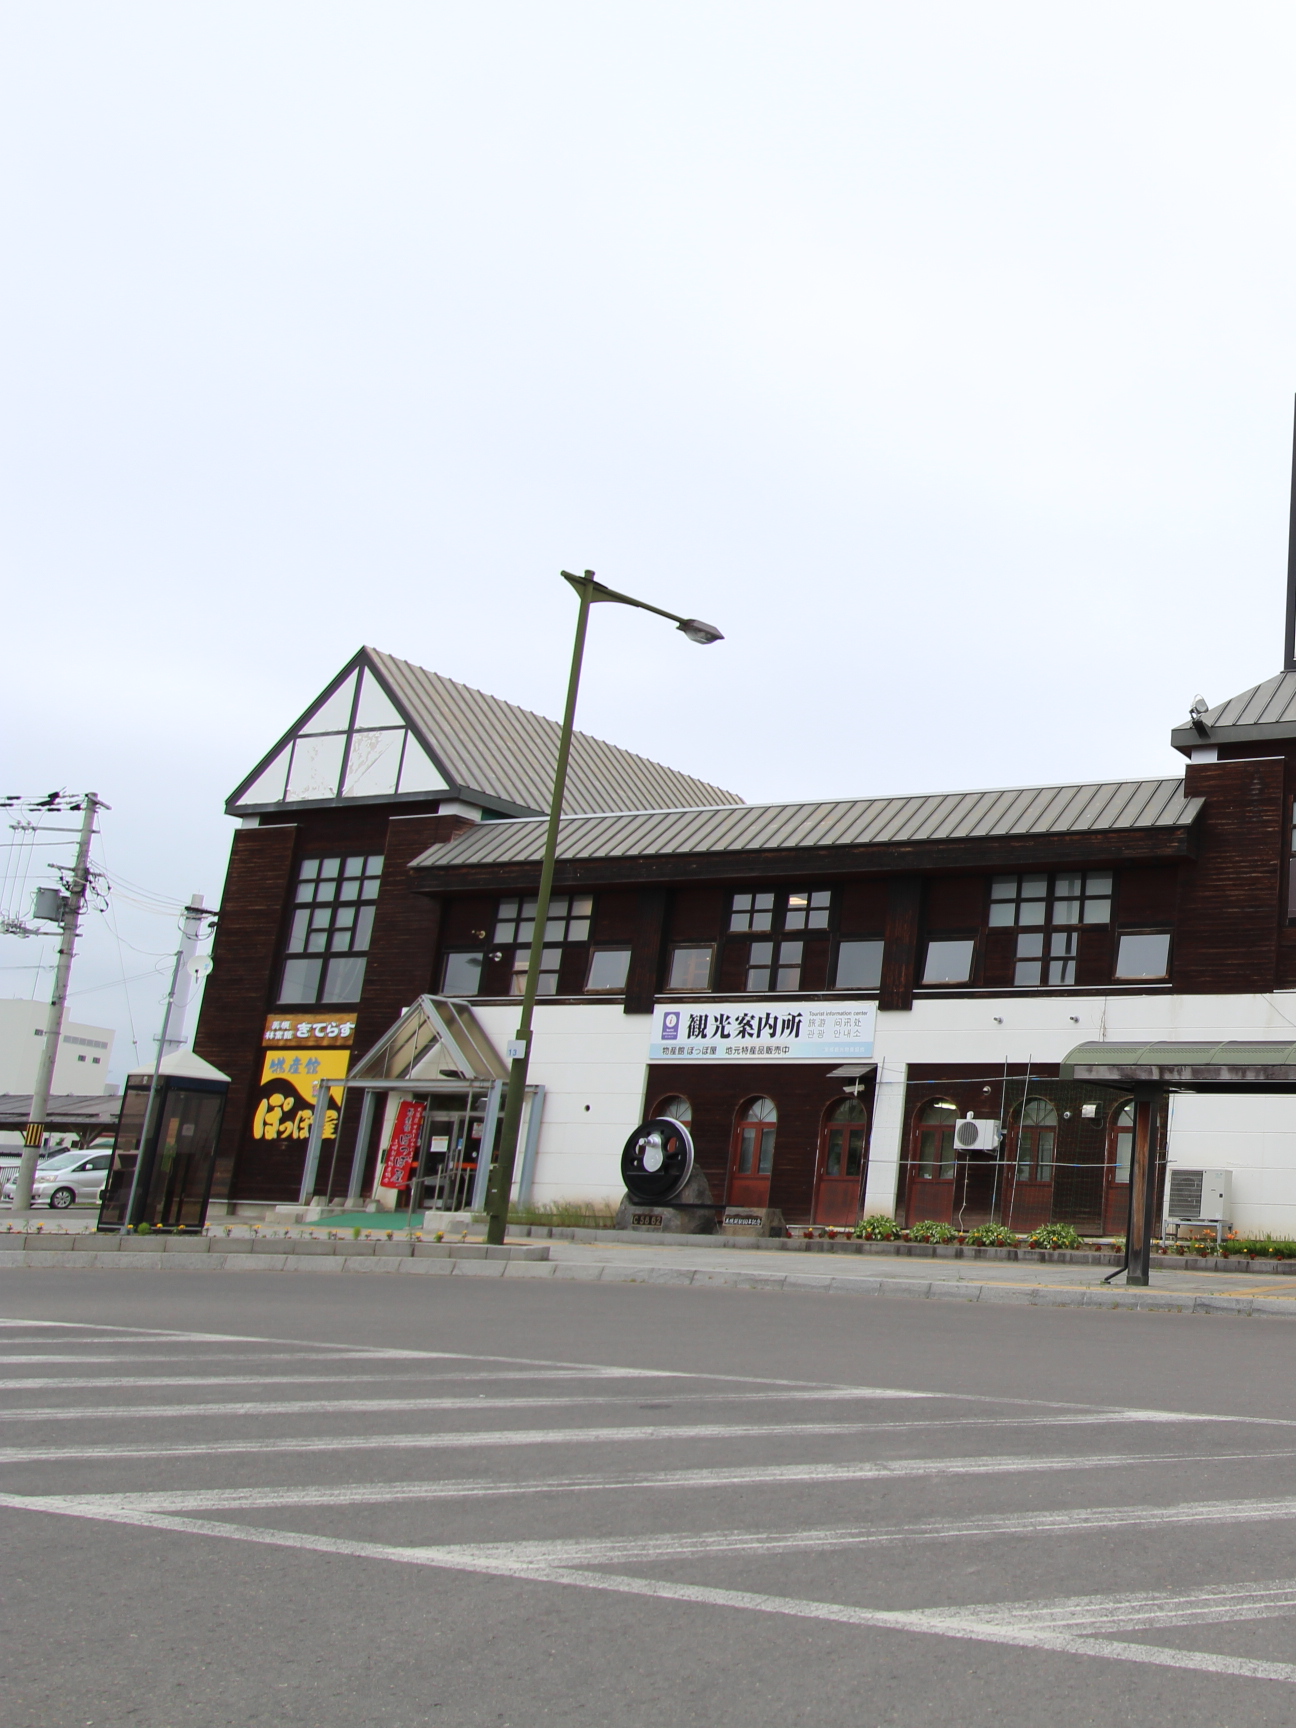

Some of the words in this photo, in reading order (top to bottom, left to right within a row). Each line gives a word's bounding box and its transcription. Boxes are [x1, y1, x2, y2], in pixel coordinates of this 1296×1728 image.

[296, 1022, 356, 1038] きてらす
[686, 1012, 804, 1039] 観光案内所
[807, 1028, 825, 1039] 관광
[833, 1028, 861, 1039] 안내소
[508, 1049, 518, 1057] 13
[725, 1046, 790, 1055] 地元特産品販売中
[269, 1056, 321, 1075] 物産館
